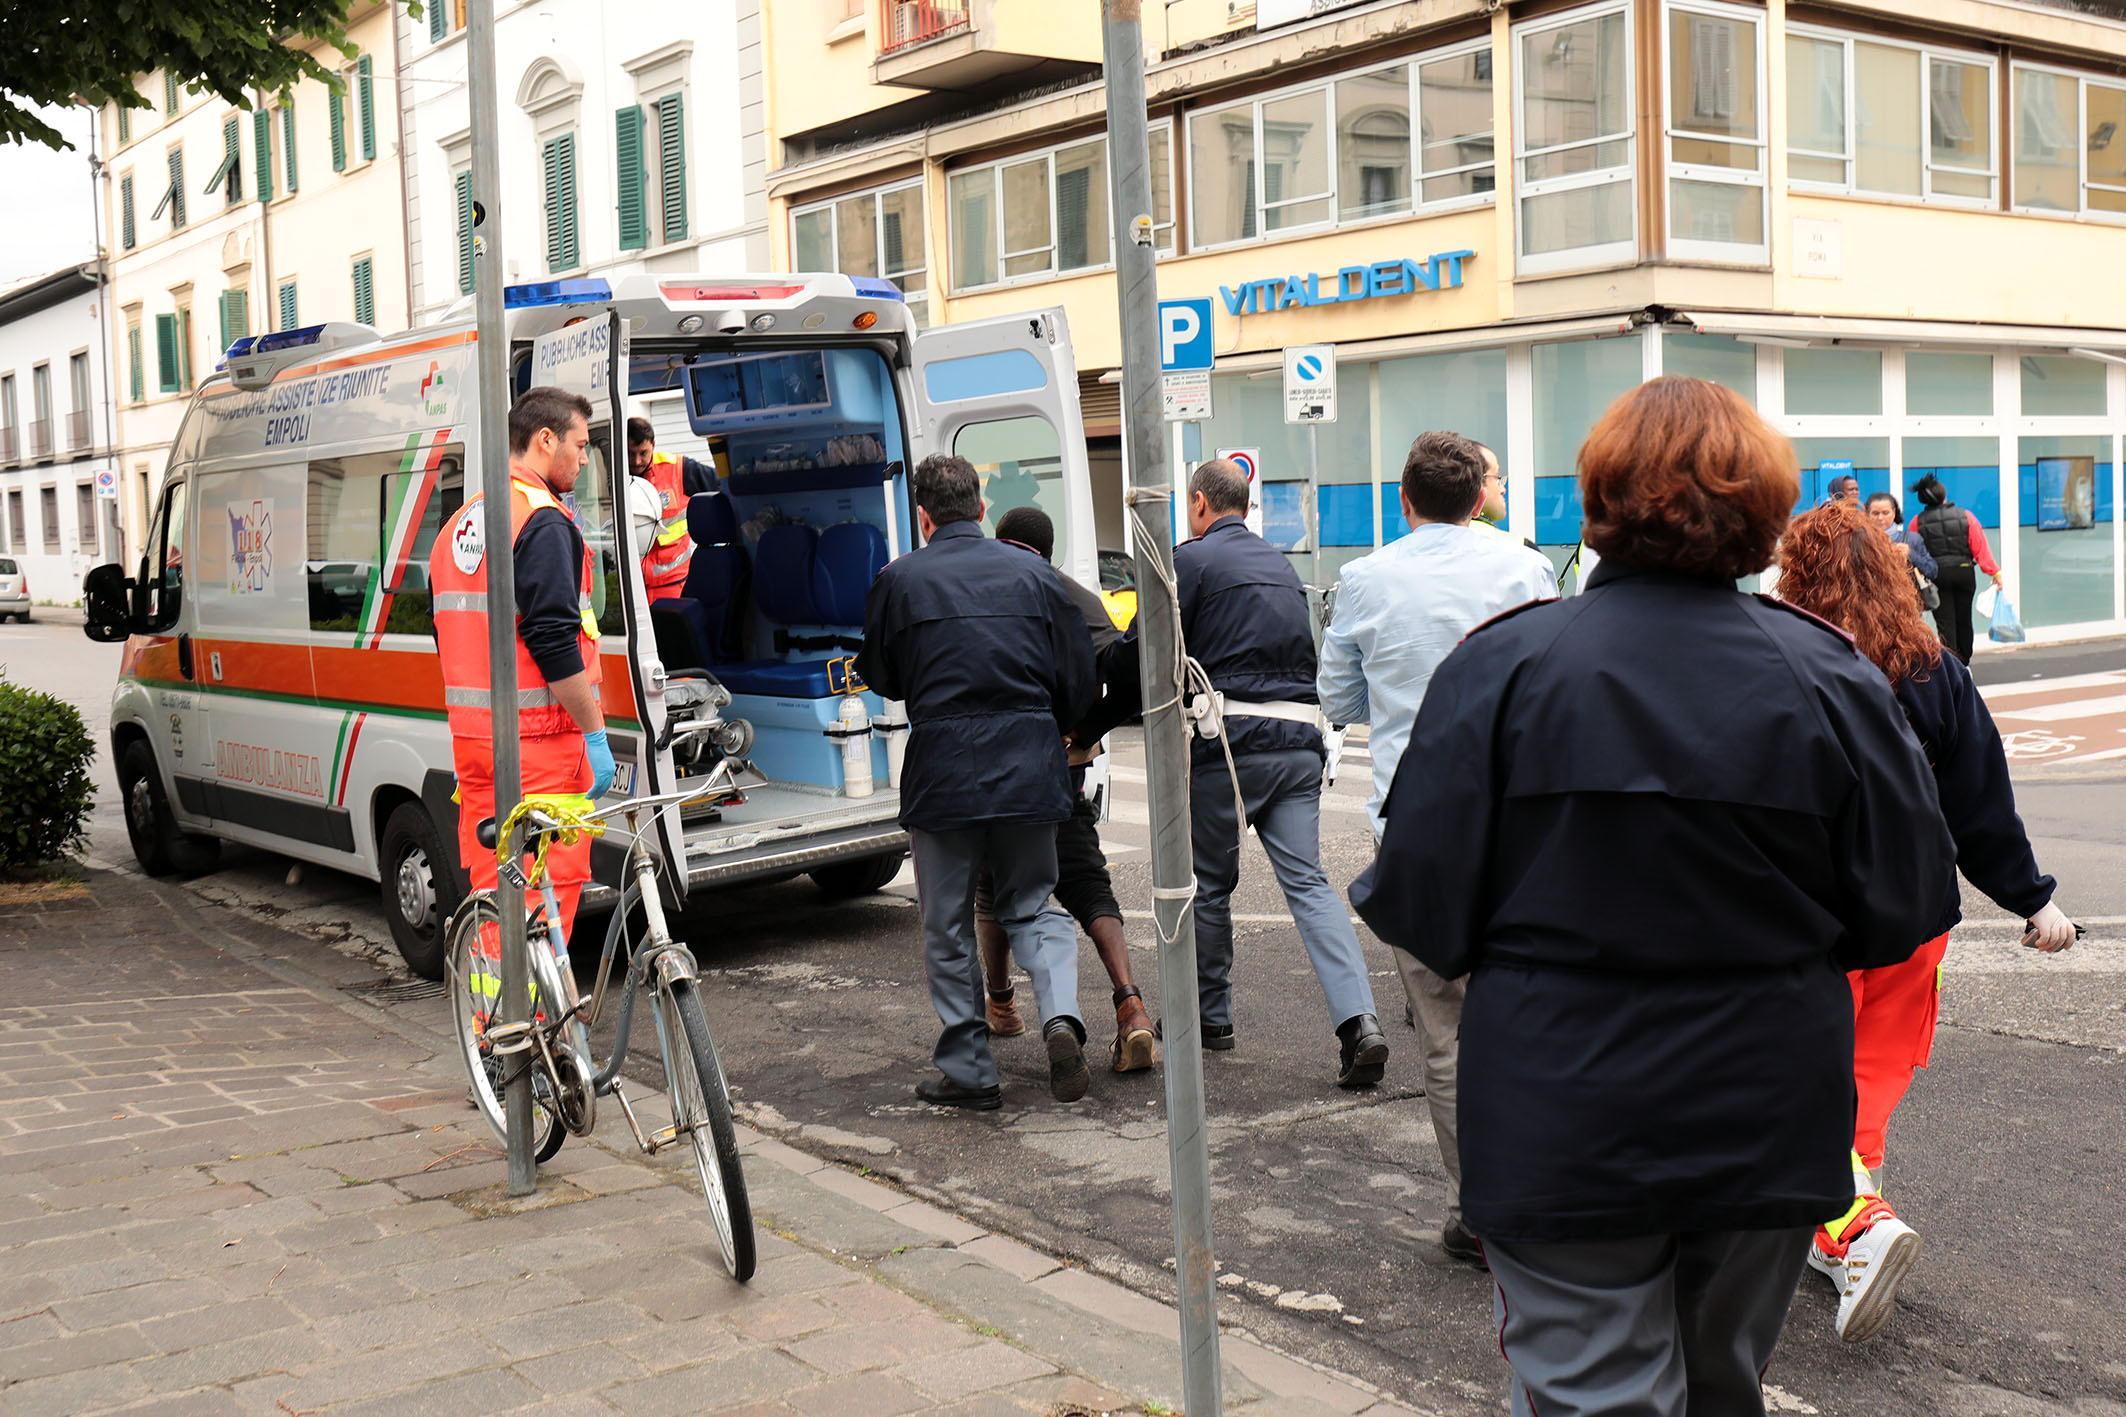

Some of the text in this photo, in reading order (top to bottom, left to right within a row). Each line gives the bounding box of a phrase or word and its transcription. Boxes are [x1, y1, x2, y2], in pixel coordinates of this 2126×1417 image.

[1219, 249, 1474, 316] VITALDENT
[541, 331, 587, 370] PUBBLICHE
[1161, 306, 1200, 364] P
[267, 375, 340, 413] ASSISTENZE
[339, 364, 392, 402] RIUNITE
[265, 413, 312, 446] EMPOLI
[239, 530, 262, 552] 118
[217, 740, 324, 798] AMBULANZA
